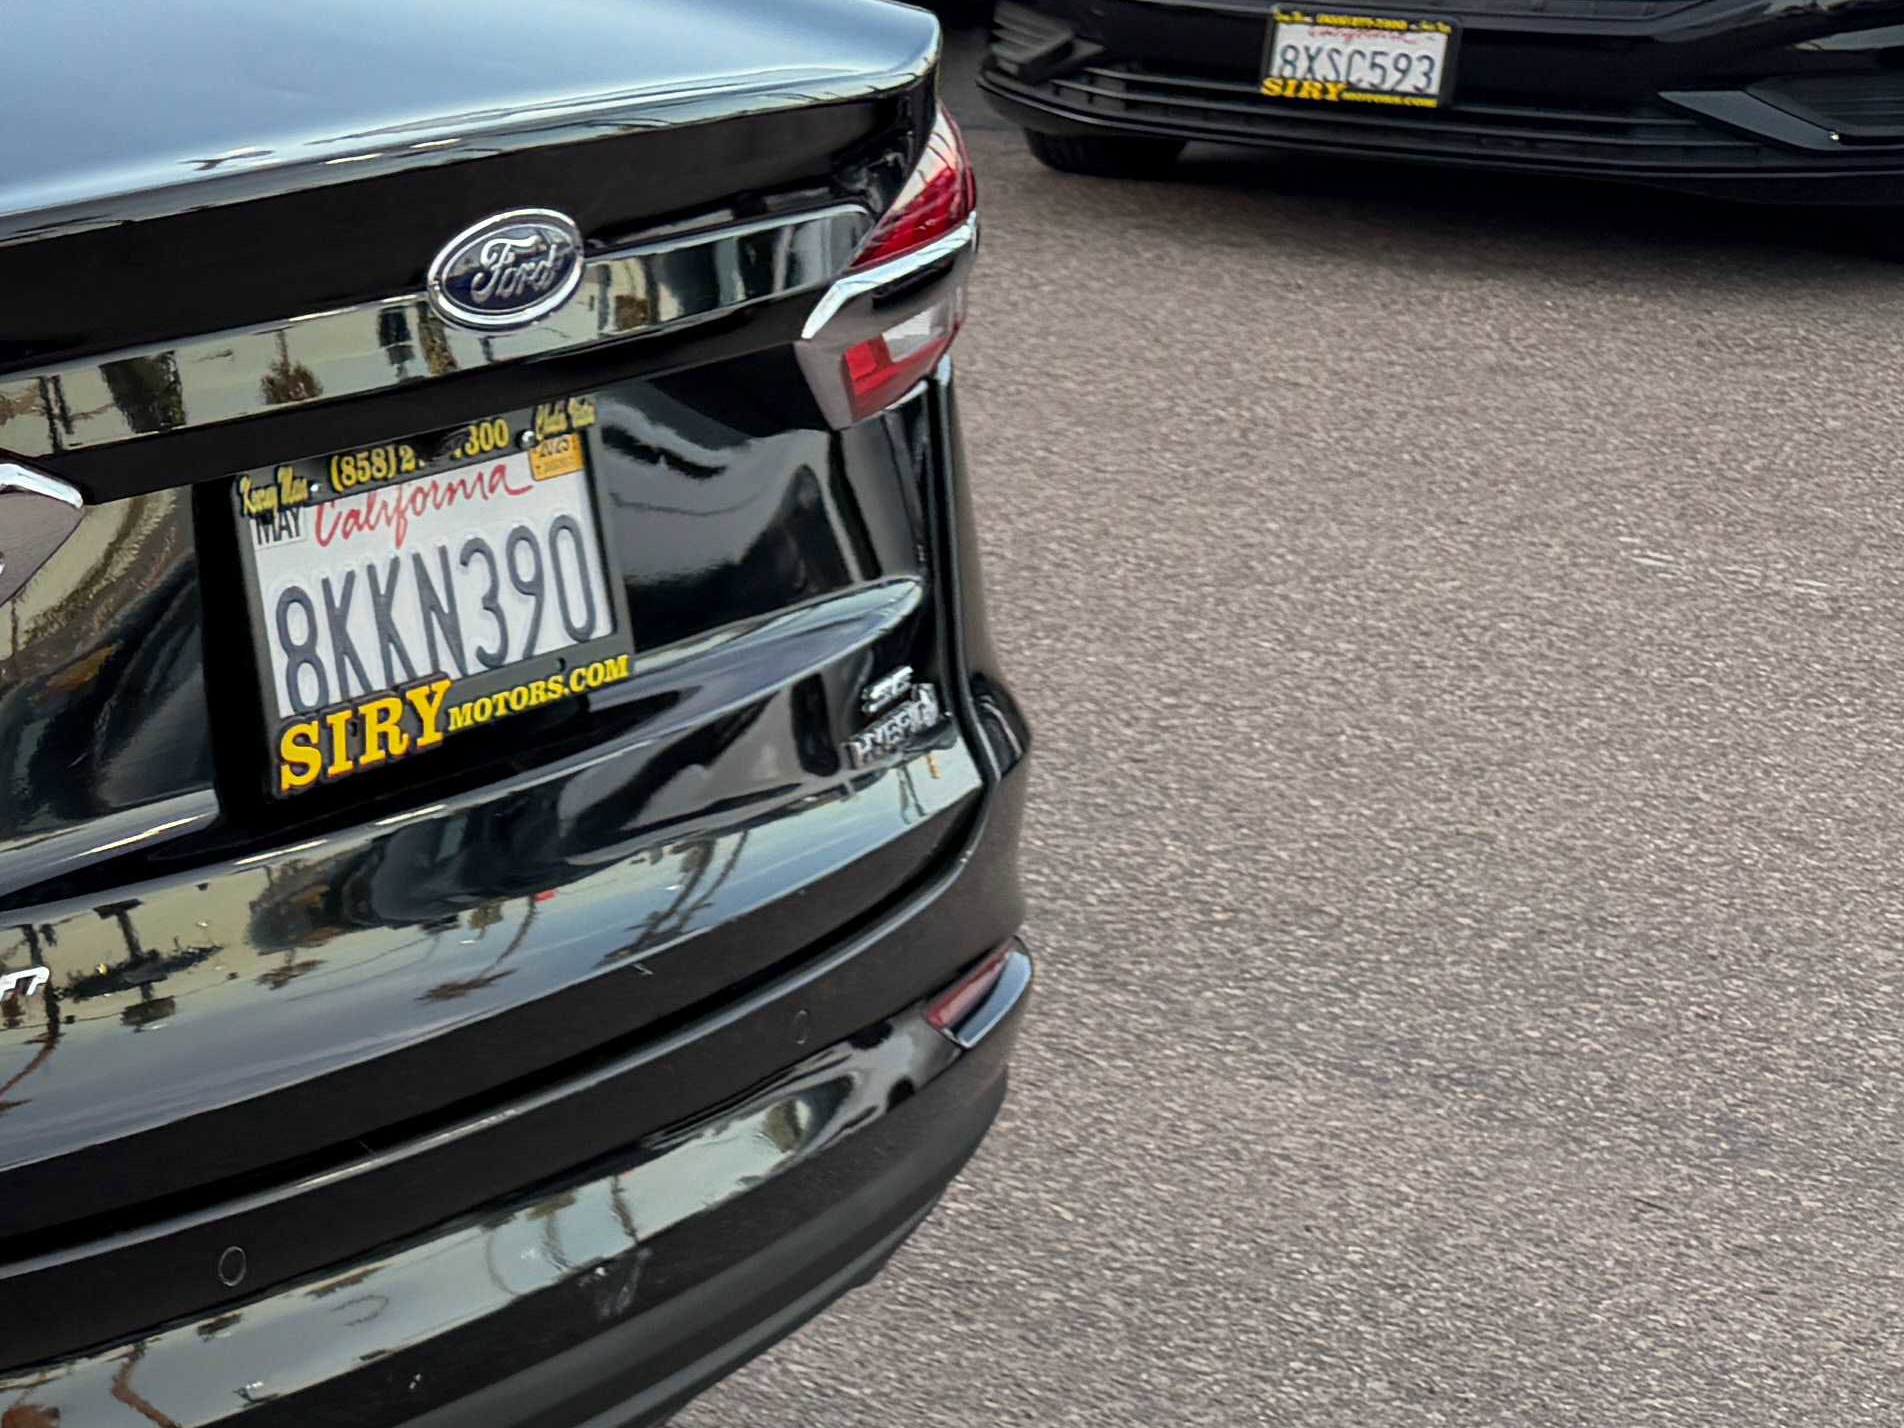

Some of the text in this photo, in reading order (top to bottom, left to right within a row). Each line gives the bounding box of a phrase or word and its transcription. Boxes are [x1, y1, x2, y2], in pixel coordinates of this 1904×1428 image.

[1280, 44, 1436, 94] 8XSC593
[470, 234, 558, 304] Ford
[330, 445, 397, 492] (858)
[255, 509, 305, 546] MAY
[314, 463, 535, 549] California
[276, 514, 594, 714] 8KKN390
[280, 654, 631, 793] SIRY MOTORS.COM
